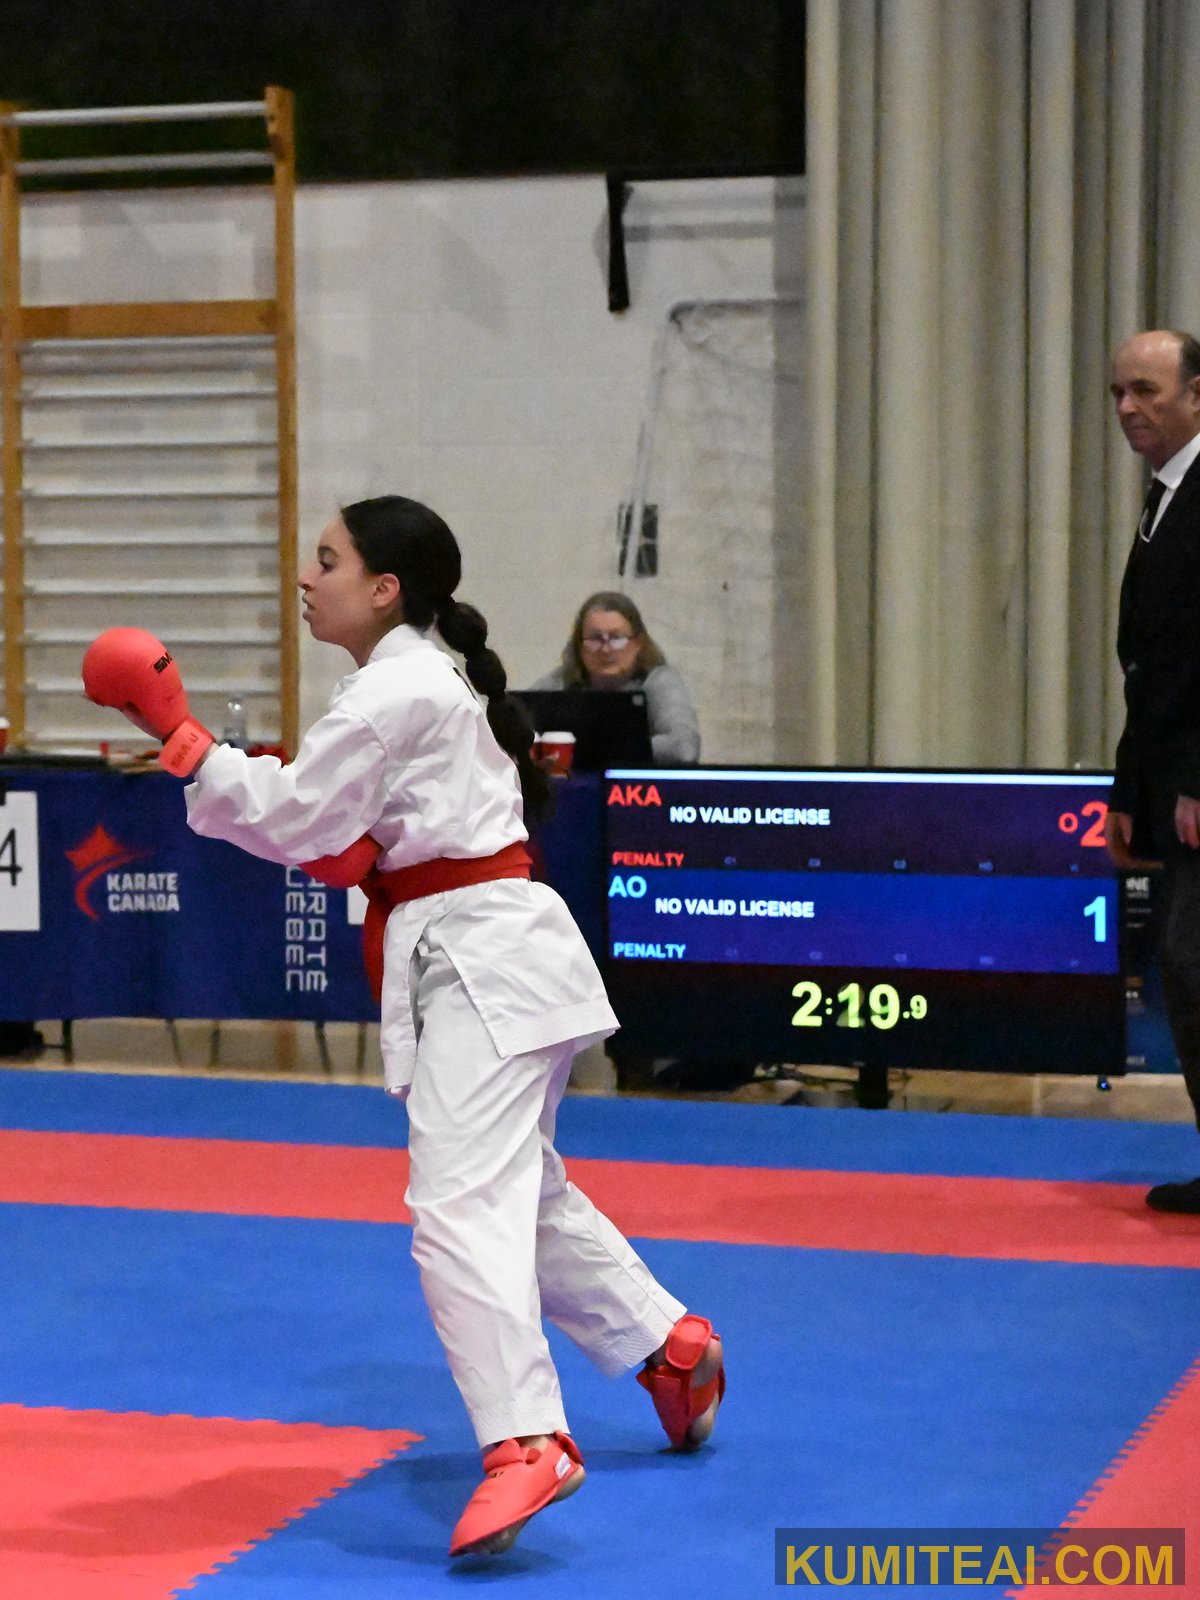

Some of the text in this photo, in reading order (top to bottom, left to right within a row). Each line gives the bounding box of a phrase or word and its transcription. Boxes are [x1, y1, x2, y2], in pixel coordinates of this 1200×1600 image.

[607, 784, 662, 806] AKA
[669, 806, 831, 826] NO VALID LICENSE
[612, 851, 685, 867] PENALTY
[107, 873, 178, 892] KARATE
[608, 875, 648, 899] AO
[108, 893, 180, 912] CANADA
[655, 898, 815, 918] NO VALID LICENSE
[285, 865, 307, 992] UÉBEC
[1083, 895, 1107, 943] 1
[306, 877, 328, 992] RATÉ
[613, 942, 687, 959] PENALTY
[791, 981, 928, 1029] 2:19.9
